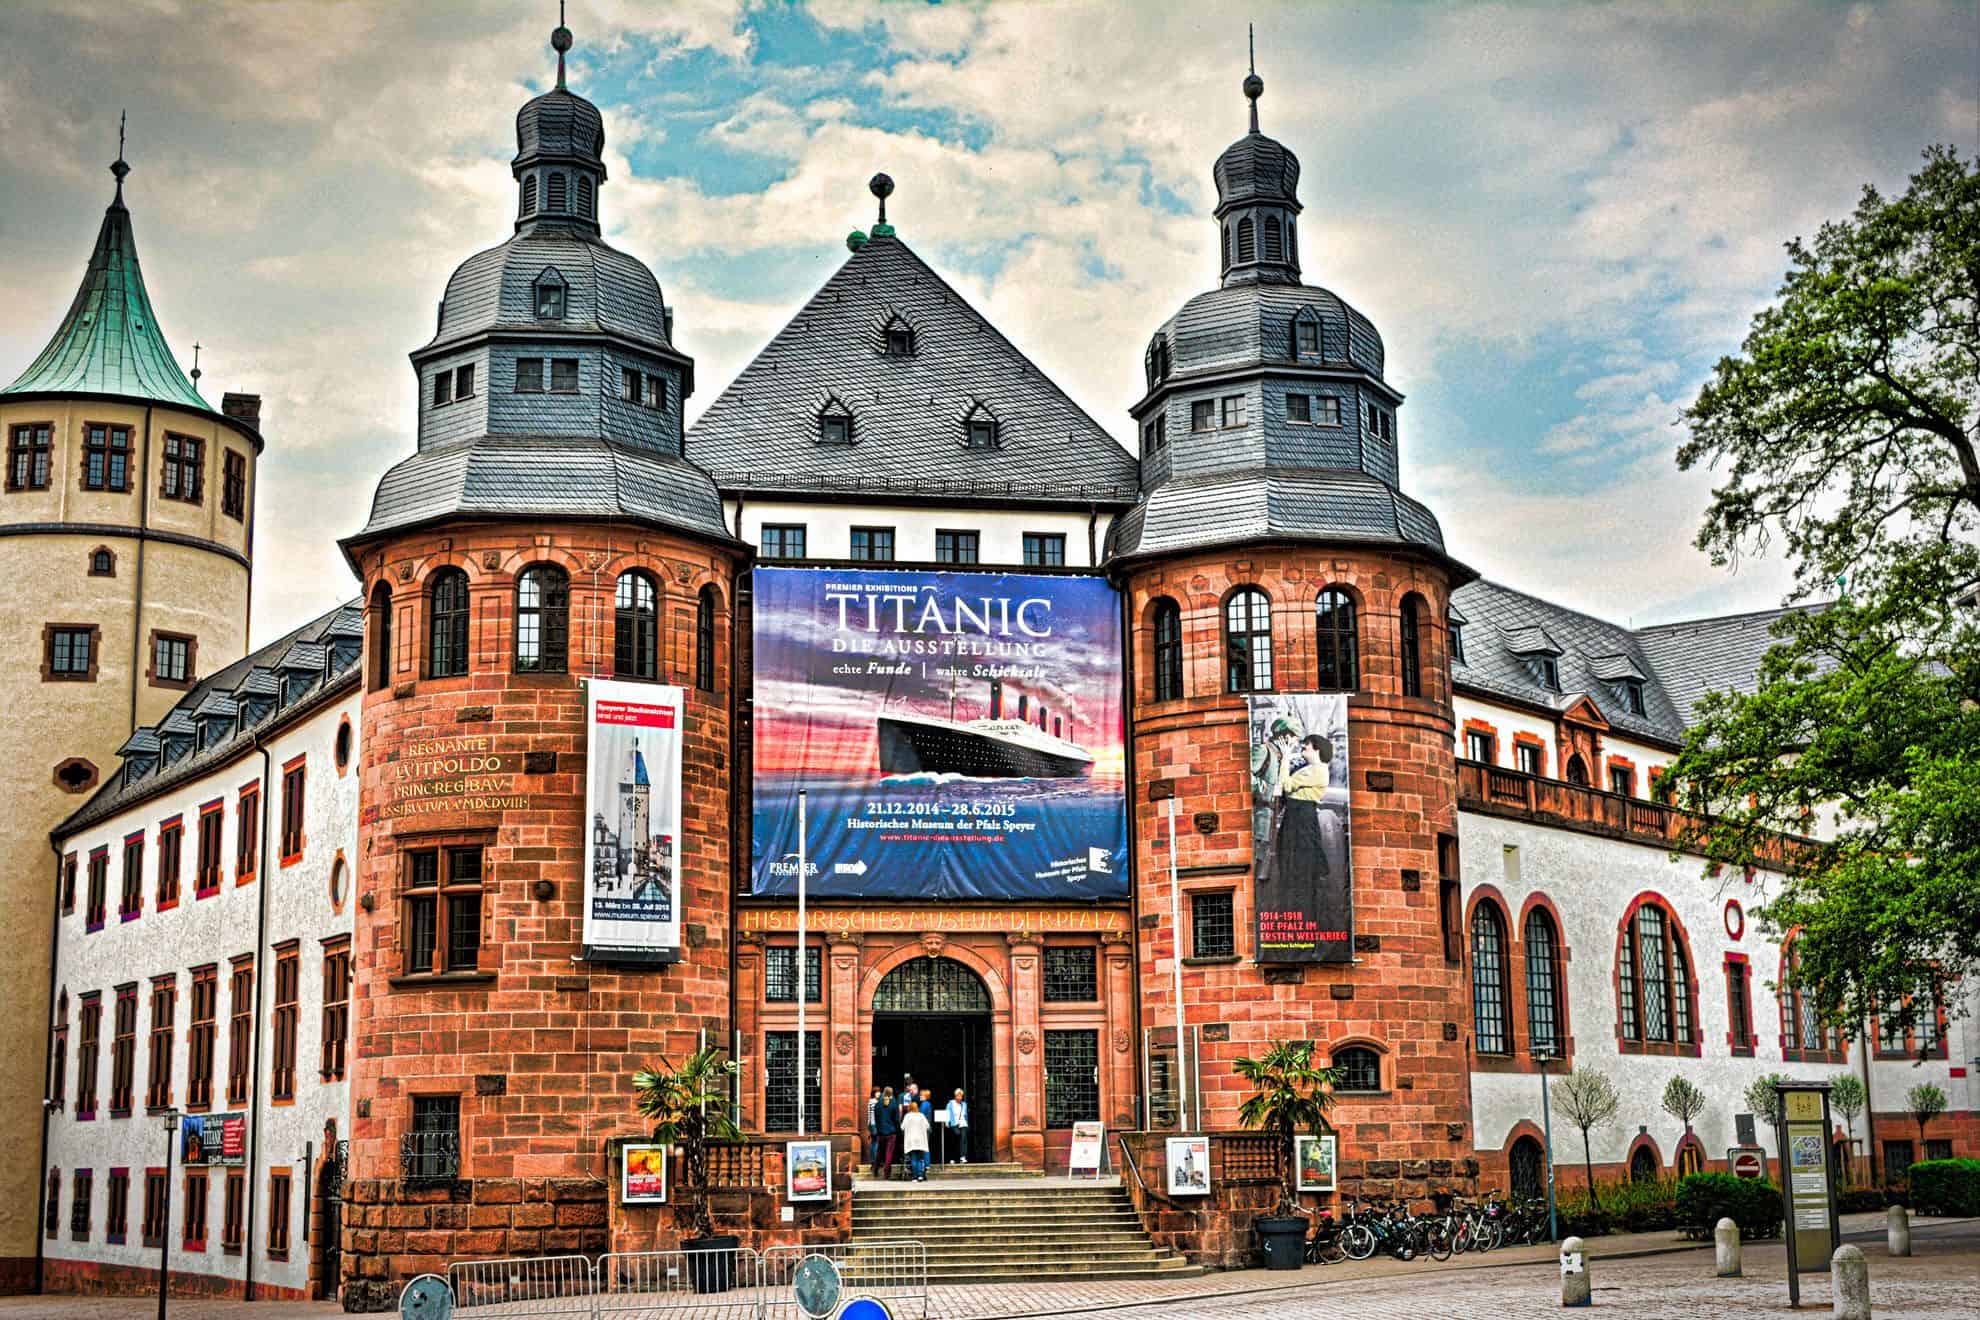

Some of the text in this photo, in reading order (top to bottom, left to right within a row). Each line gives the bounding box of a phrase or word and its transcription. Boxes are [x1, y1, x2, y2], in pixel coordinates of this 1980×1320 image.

[826, 584, 918, 593] PREMIER EXHIBITIONS
[826, 593, 1052, 637] TITANIC
[832, 639, 1046, 657] DIE AUSSTELLUNG
[833, 662, 912, 675] echte Funde
[936, 666, 968, 677] wahre
[409, 738, 488, 757] REGNANTE
[867, 802, 940, 815] 21.12.2014
[952, 803, 1015, 816] 28.6.2015
[847, 818, 1036, 833] Historisches Museum der Pfalz Speyer
[769, 862, 819, 874] PREMER
[745, 911, 1120, 930] HISTORISCHES MUSEUM DER PFALZ
[1260, 921, 1317, 931] DIE PFALZ IM
[1260, 931, 1348, 941] ERSTEN WELTKRIEG
